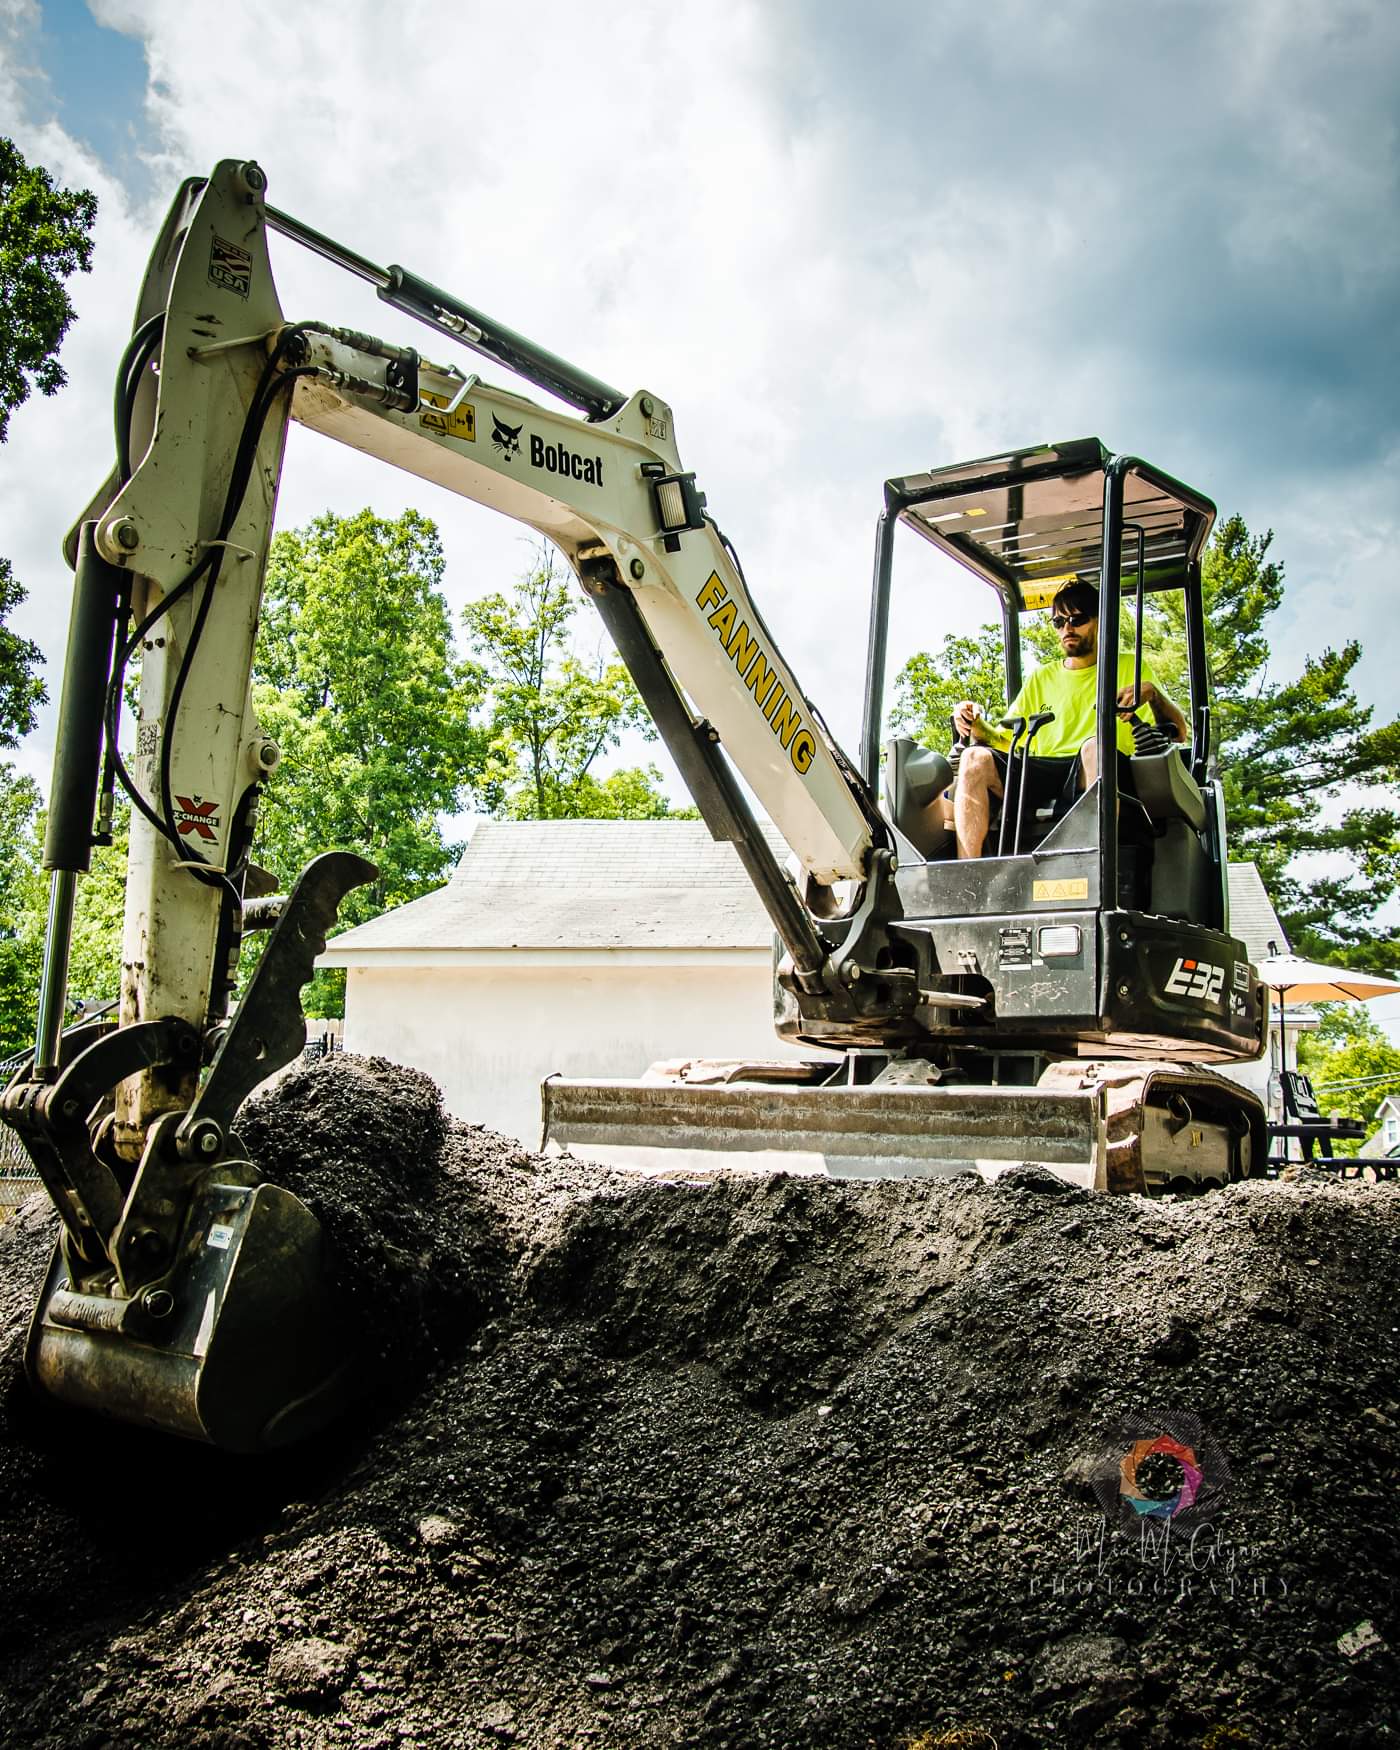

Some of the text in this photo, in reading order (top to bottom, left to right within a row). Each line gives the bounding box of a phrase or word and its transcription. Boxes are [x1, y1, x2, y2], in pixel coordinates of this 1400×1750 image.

[212, 267, 246, 292] USA
[530, 434, 603, 487] Bobcat
[696, 569, 816, 775] FANNING
[1164, 957, 1225, 1005] E32
